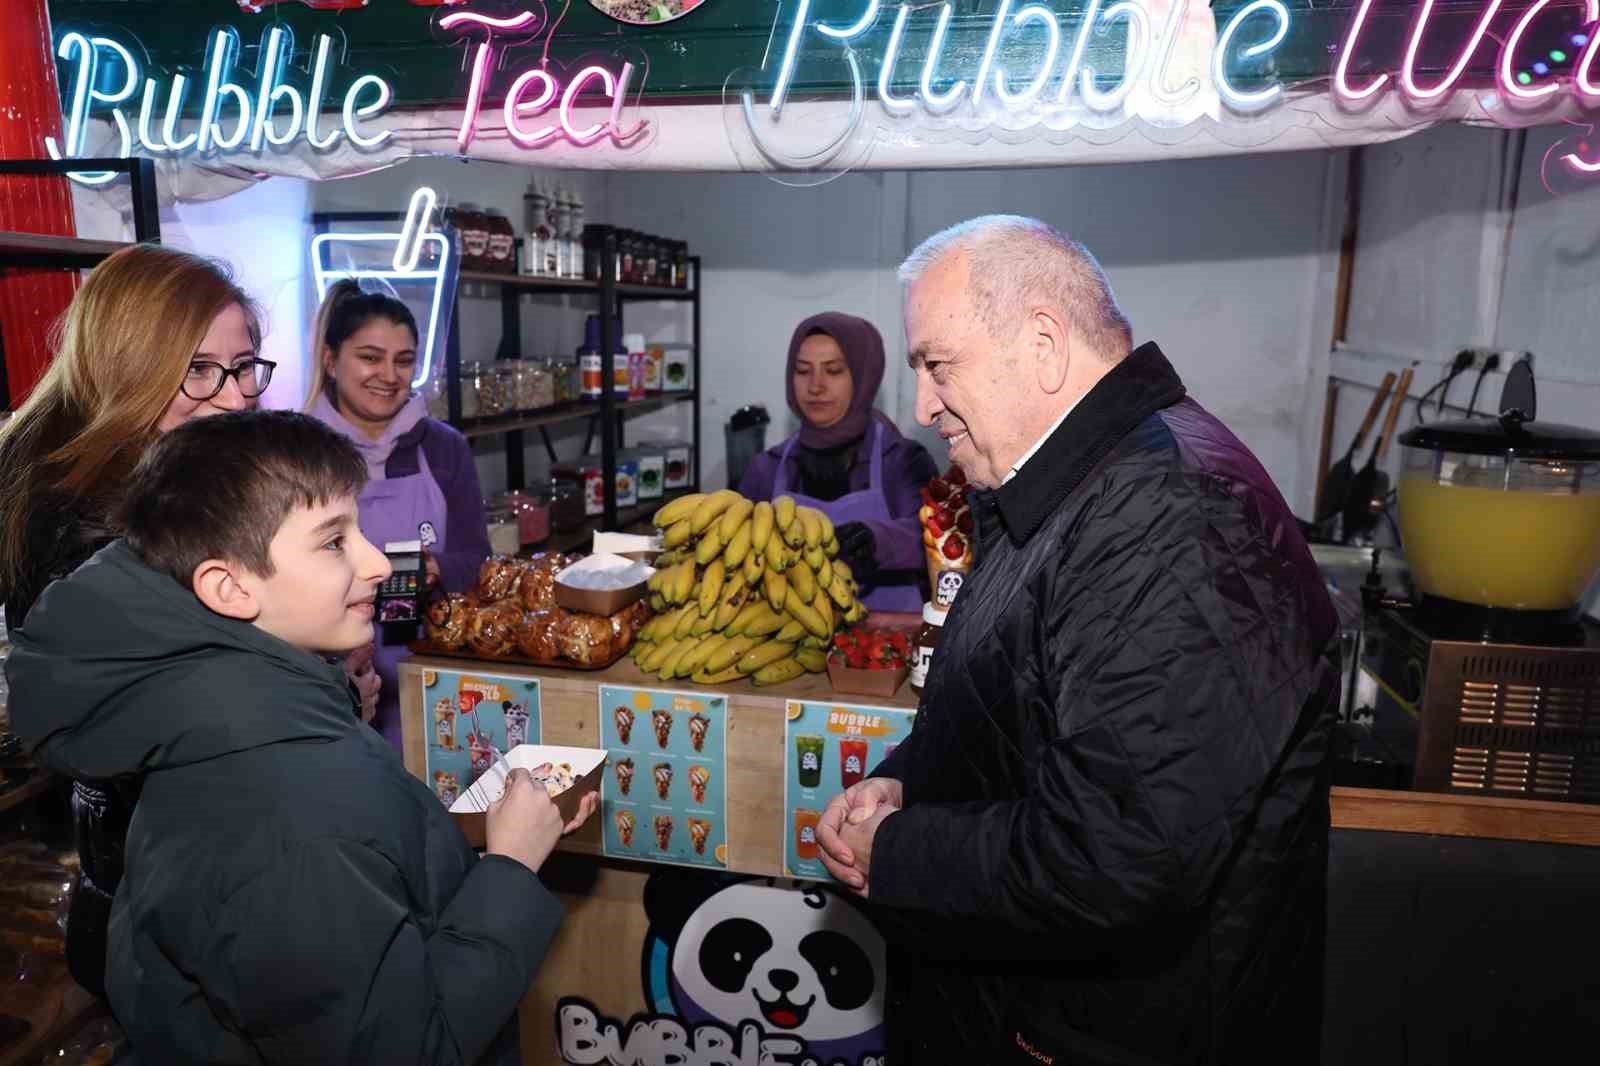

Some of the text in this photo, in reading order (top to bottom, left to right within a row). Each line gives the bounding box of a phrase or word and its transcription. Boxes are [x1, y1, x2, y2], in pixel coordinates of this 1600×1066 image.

[47, 9, 648, 185] Bubble Tea
[741, 0, 1290, 161] Bubble
[830, 711, 881, 729] BUBBLE
